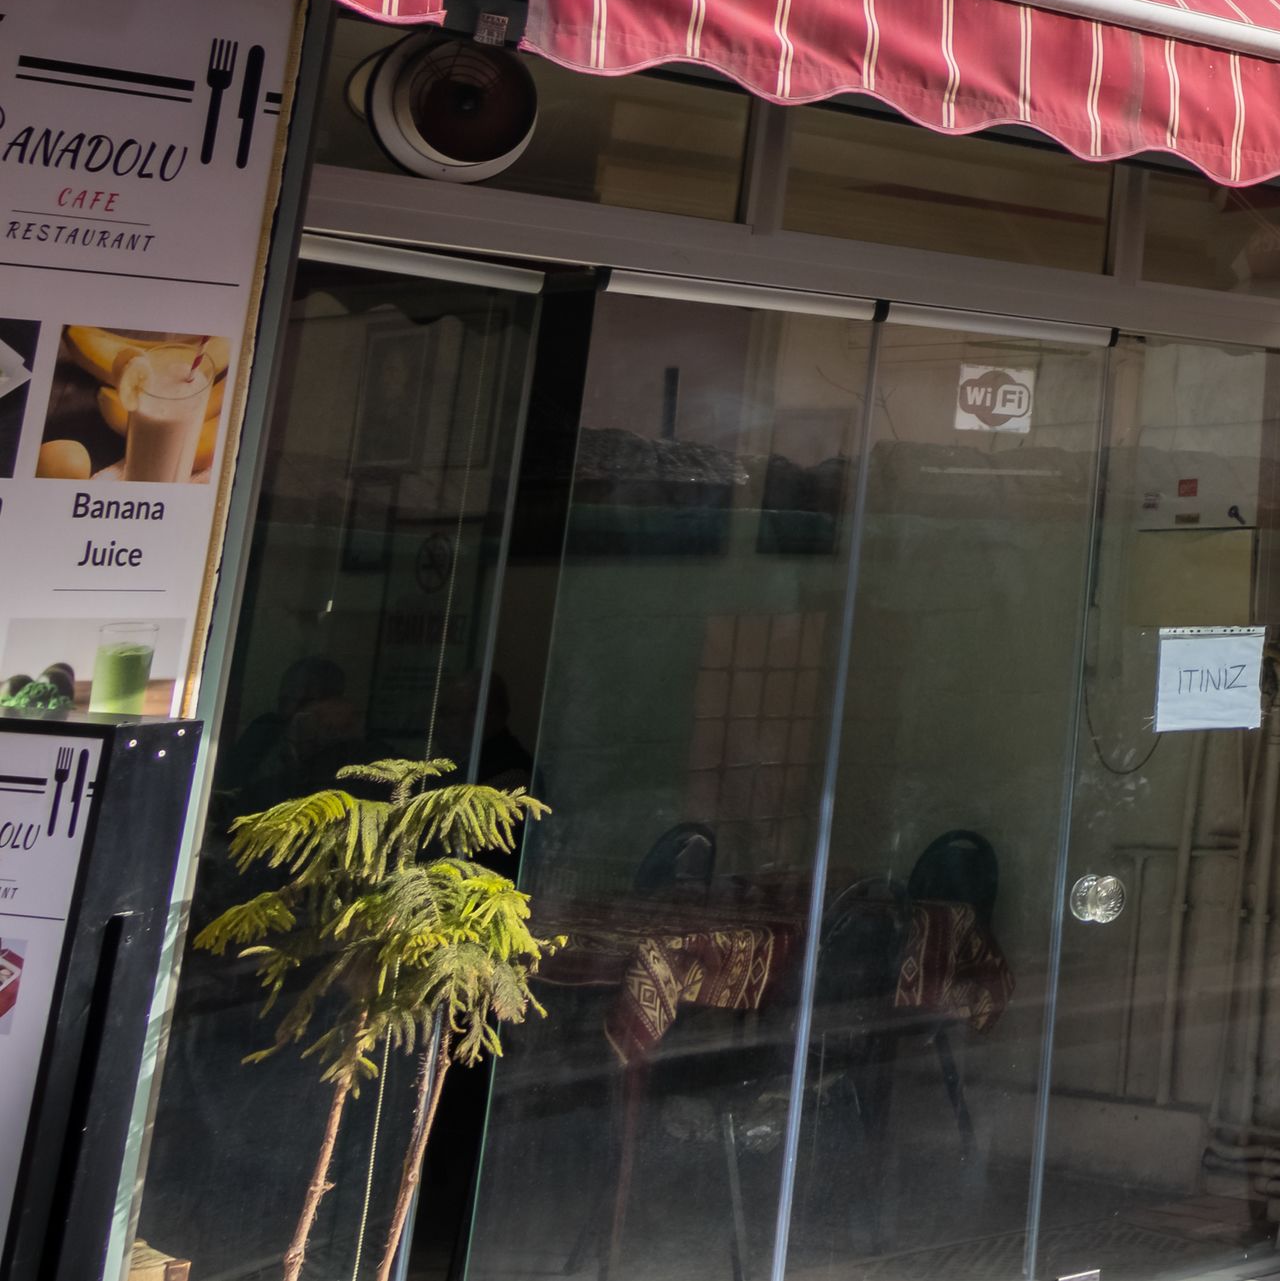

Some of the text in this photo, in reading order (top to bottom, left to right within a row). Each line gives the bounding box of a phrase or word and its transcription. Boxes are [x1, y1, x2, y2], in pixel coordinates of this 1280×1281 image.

[57, 187, 119, 212] CAFE
[6, 221, 155, 251] RESTAURANT
[72, 492, 165, 521] Banana
[78, 540, 142, 567] Juice
